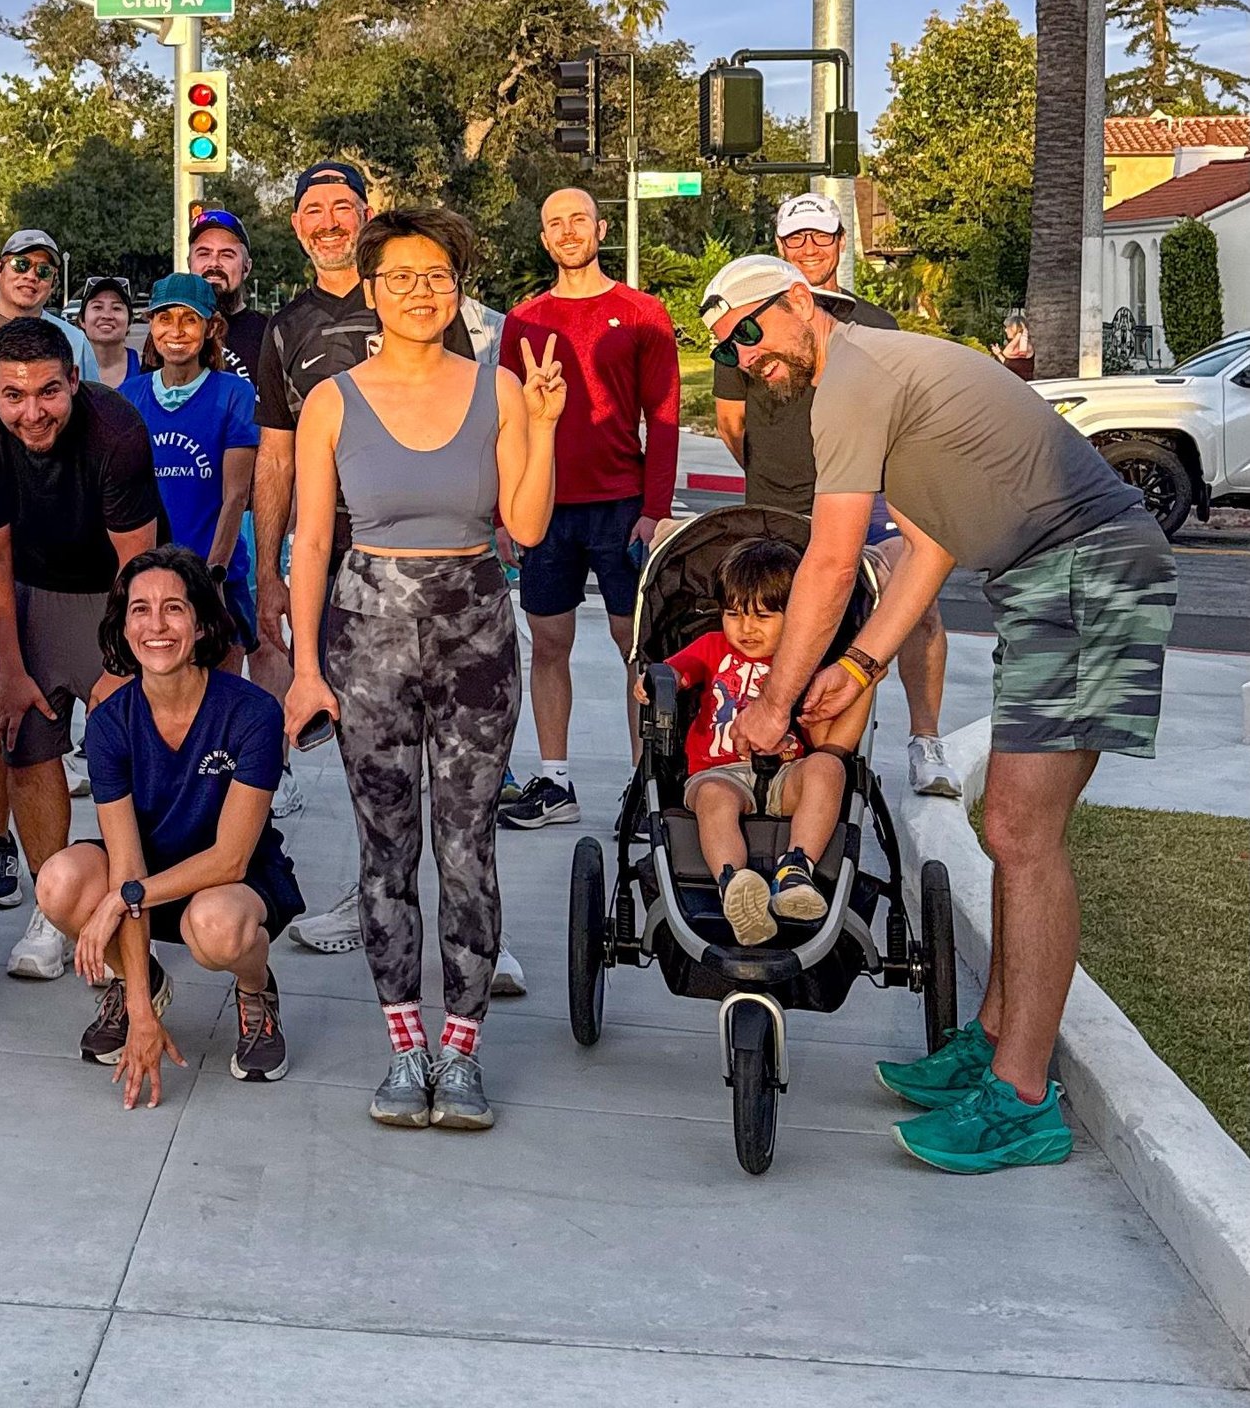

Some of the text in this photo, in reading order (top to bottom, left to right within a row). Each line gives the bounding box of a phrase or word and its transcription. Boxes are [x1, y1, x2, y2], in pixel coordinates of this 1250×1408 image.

[153, 432, 213, 479] WITH US
[154, 466, 195, 478] ADENA
[198, 754, 213, 775] RUN
